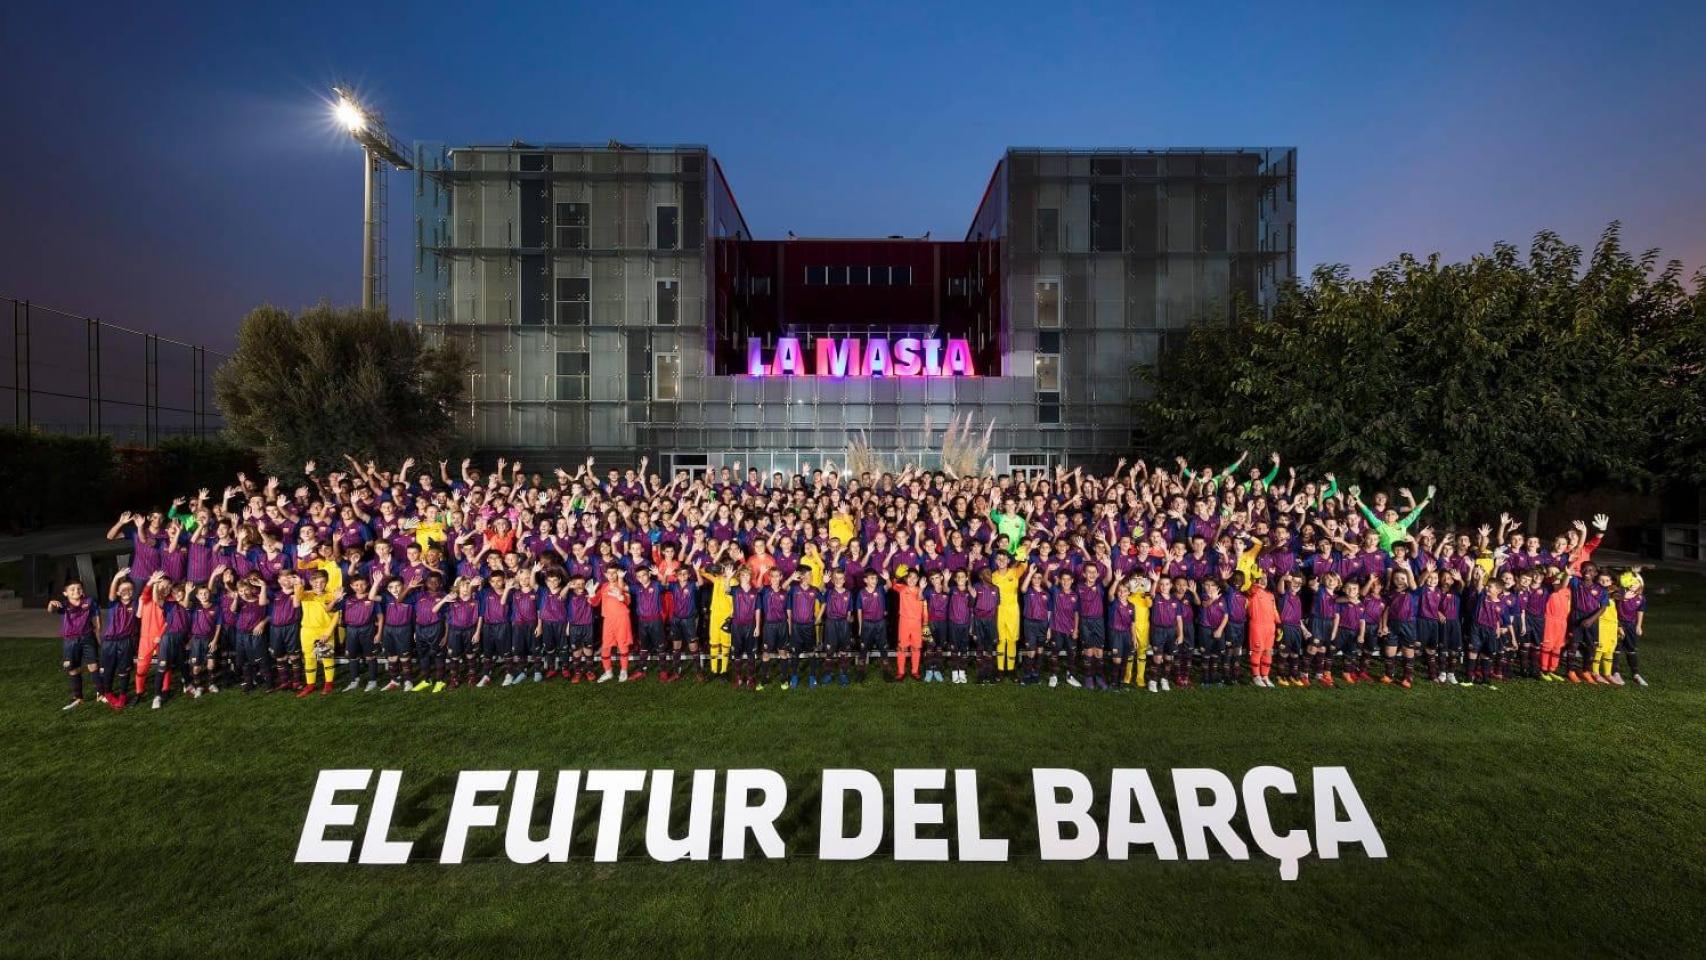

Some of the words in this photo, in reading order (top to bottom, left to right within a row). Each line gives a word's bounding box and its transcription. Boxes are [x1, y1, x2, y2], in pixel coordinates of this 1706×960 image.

[748, 337, 805, 376] LA
[816, 338, 975, 376] MASIA
[294, 769, 414, 864] EL
[440, 768, 787, 864] FUTUR
[819, 768, 1009, 861] DEL
[1032, 765, 1388, 881] BARÇA
